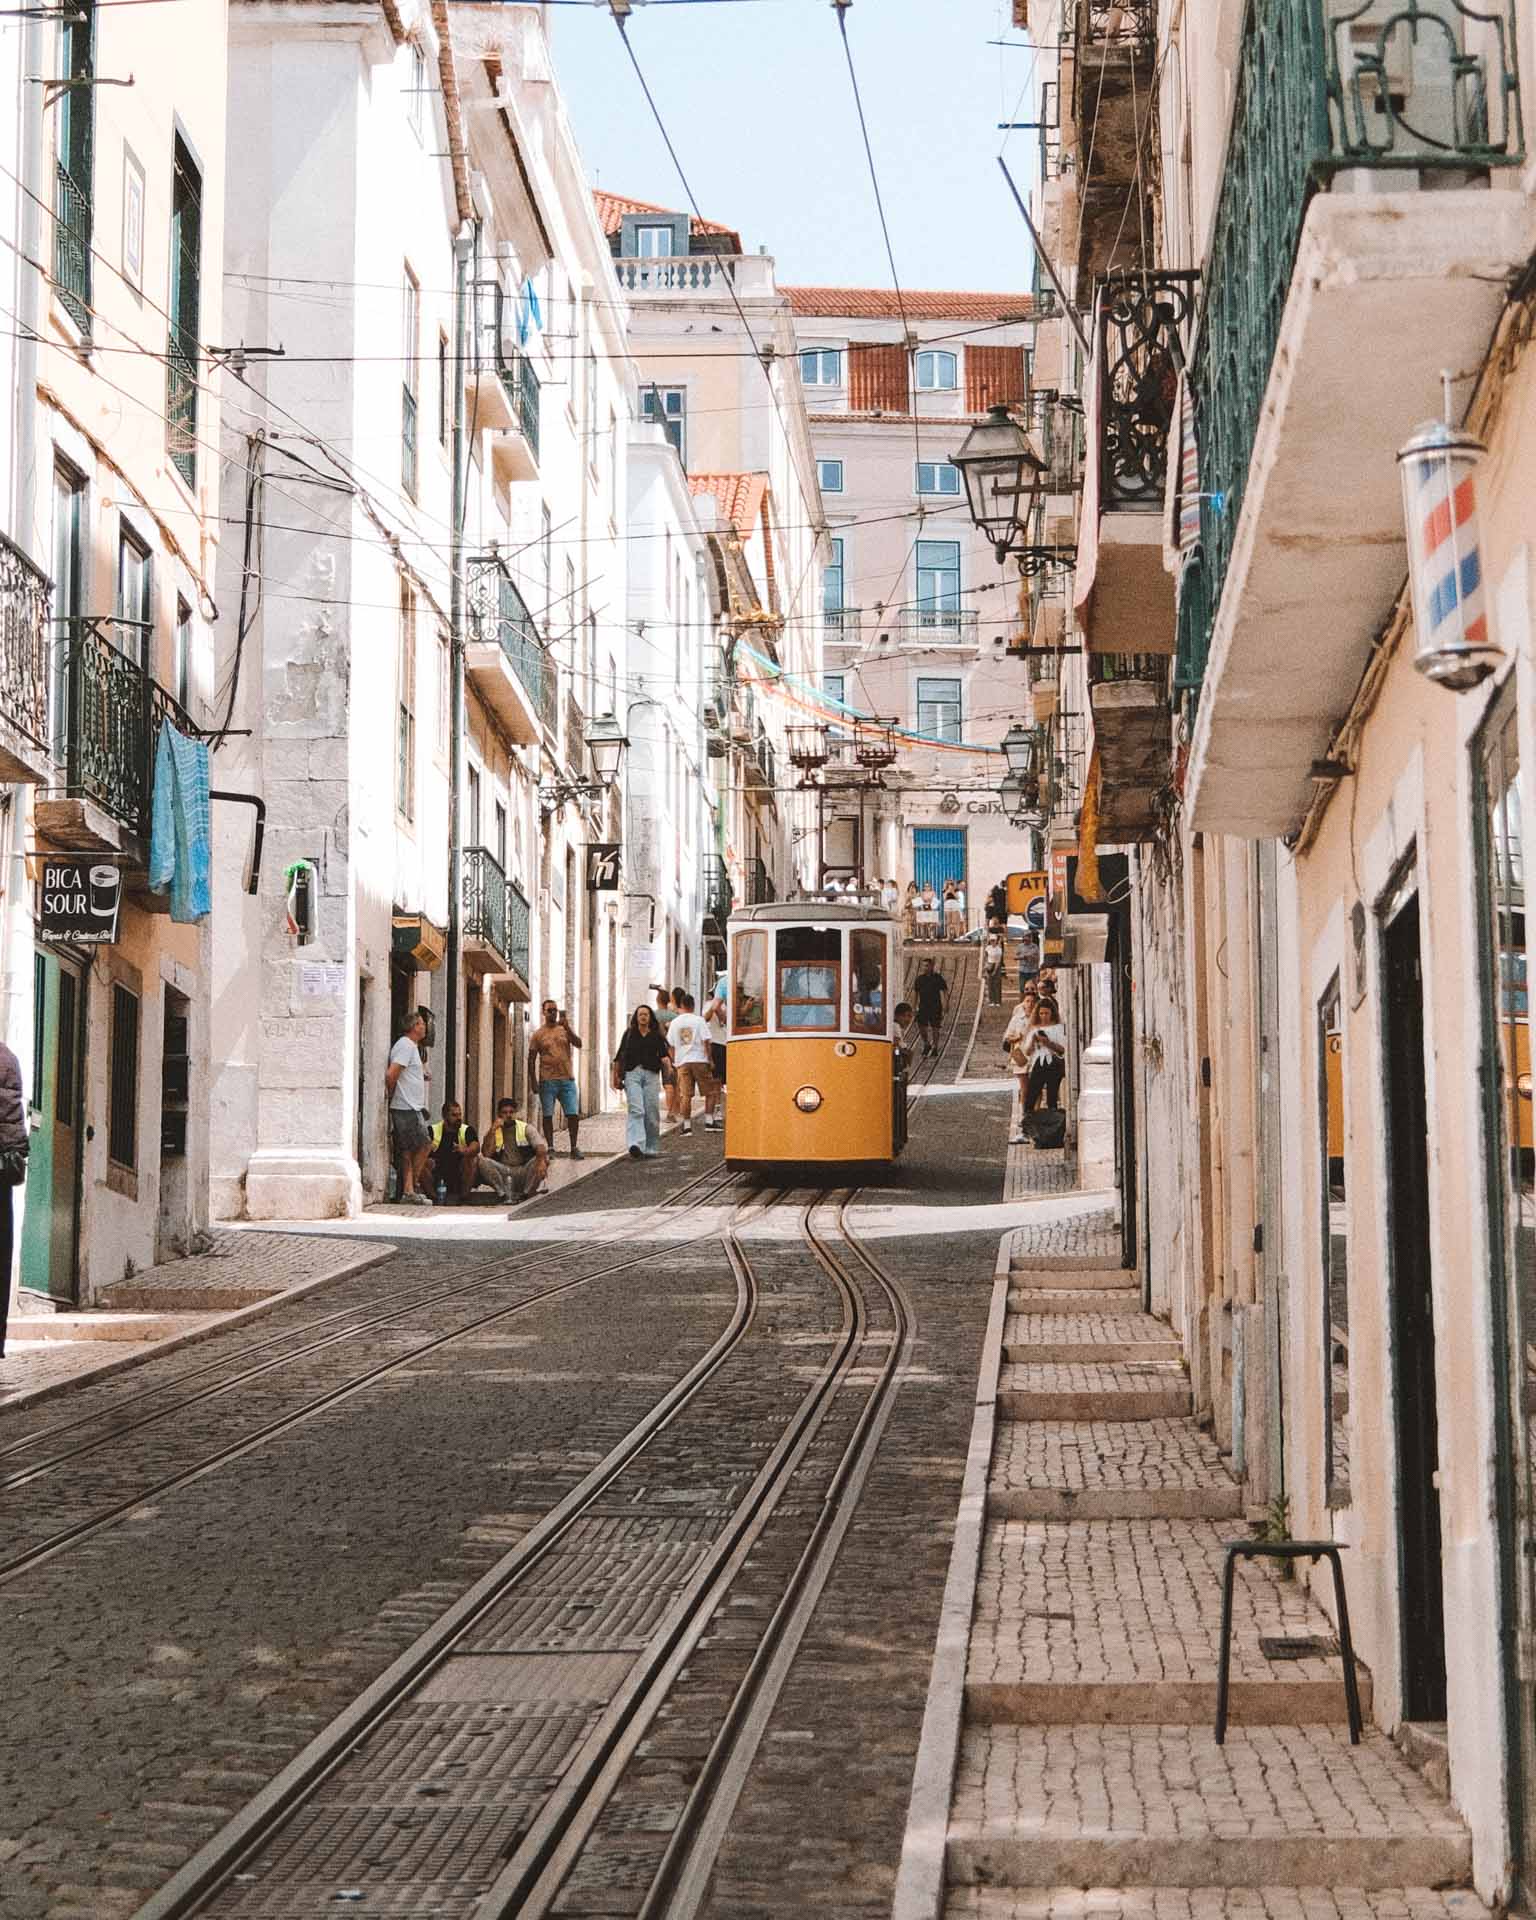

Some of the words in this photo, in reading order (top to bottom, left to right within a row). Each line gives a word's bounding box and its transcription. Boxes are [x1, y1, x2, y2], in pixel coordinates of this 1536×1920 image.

[966, 800, 1003, 814] Caix
[46, 868, 82, 889] BICA
[44, 893, 87, 915] SOUR
